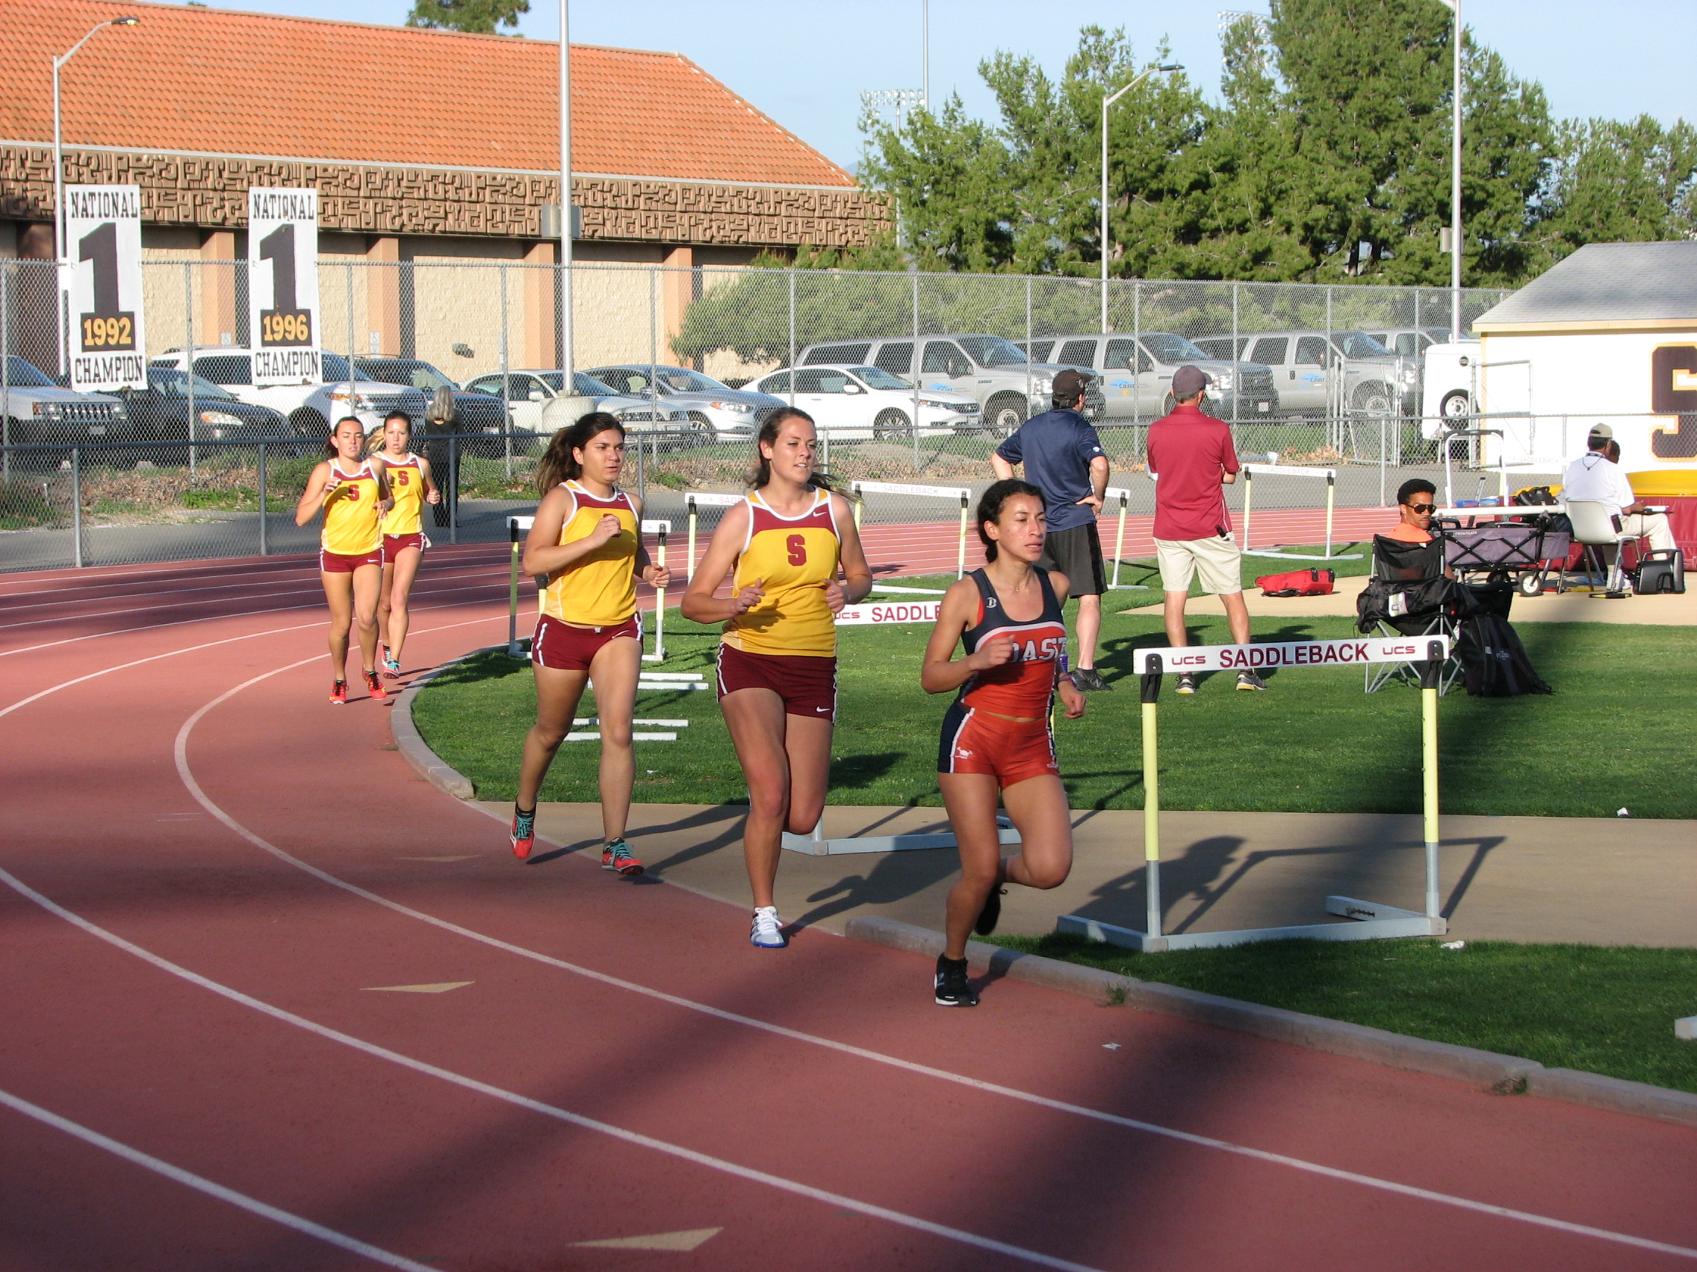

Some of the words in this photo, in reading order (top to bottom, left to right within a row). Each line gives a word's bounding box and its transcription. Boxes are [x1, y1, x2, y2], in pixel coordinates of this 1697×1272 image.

[71, 192, 138, 218] NATIONAL
[253, 194, 315, 220] NATIONAL
[79, 222, 119, 313] 1
[260, 224, 297, 310] 1
[84, 316, 132, 346] 1992
[263, 314, 309, 341] 1996
[75, 355, 143, 384] CHAMPION
[255, 351, 319, 378] CHAMPION
[398, 470, 409, 486] S
[786, 534, 807, 566] S
[1171, 655, 1206, 665] UCS
[1220, 643, 1369, 668] SADDLEBACK
[1382, 645, 1416, 655] UCS
